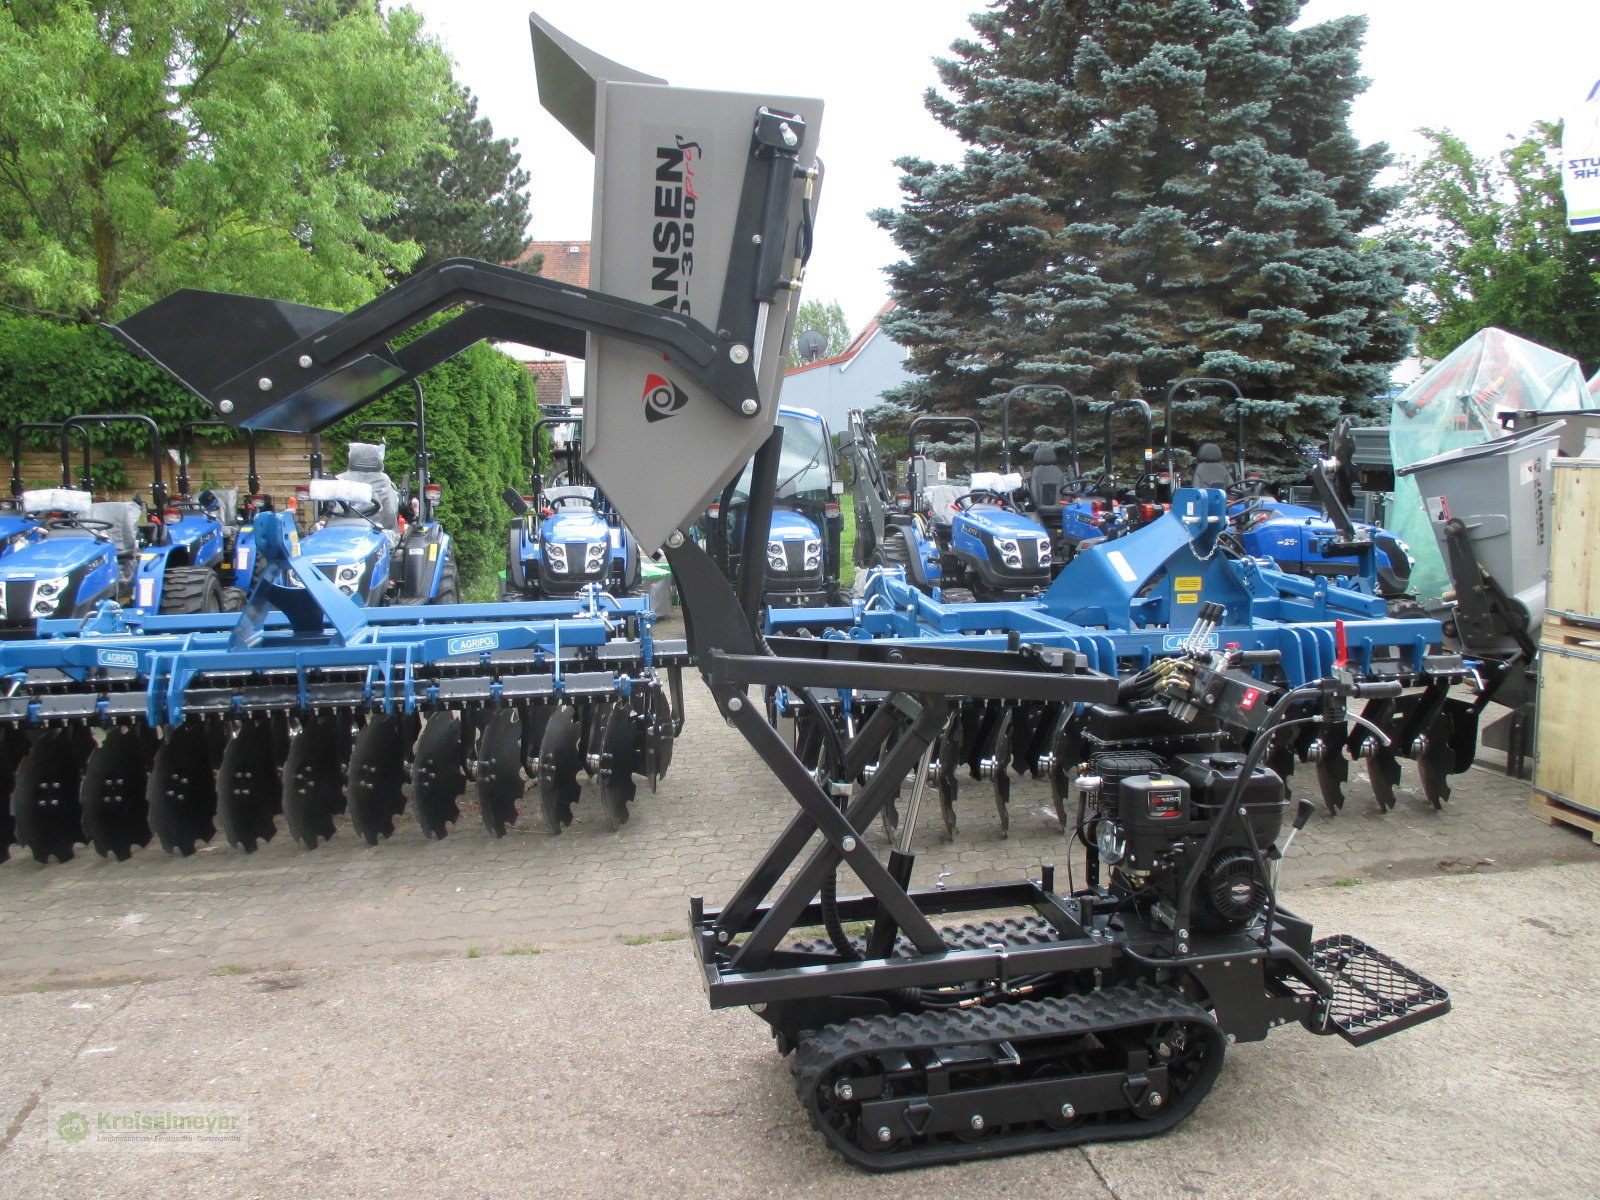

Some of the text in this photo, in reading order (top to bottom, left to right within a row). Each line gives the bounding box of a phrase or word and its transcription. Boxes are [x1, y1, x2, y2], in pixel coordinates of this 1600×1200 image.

[652, 147, 684, 312] ANSEN
[460, 635, 496, 650] AGRIPOL
[106, 653, 136, 664] AGRIPOL
